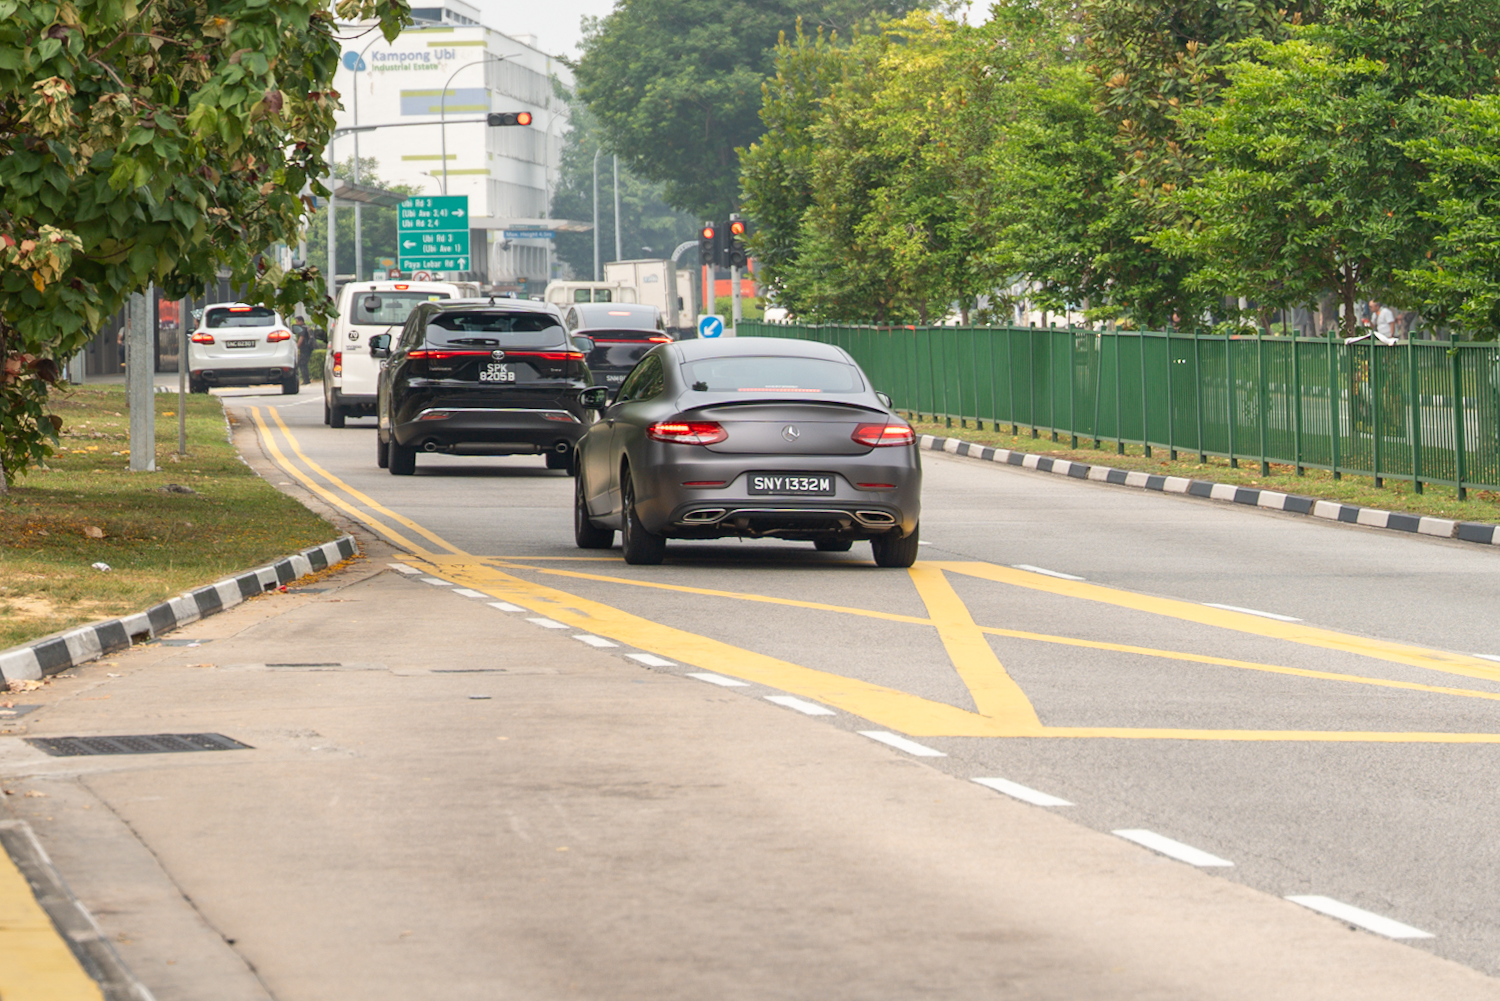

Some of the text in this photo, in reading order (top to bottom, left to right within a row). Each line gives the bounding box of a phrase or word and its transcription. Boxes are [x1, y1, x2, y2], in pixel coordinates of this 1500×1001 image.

[371, 48, 456, 63] Kampong Ubi
[371, 62, 411, 72] Industrial
[413, 62, 438, 71] Estate
[401, 198, 432, 208] Ubi Rd 3
[402, 209, 416, 218] (Ubi
[418, 209, 431, 218] Ave
[402, 219, 413, 228] Ubi
[415, 219, 425, 228] Rd
[422, 234, 453, 243] Ubi Rd 3
[422, 244, 437, 253] (Ubi
[439, 244, 452, 253] Ave
[404, 259, 454, 270] Paya Lebar Rd
[487, 363, 509, 373] SPK
[479, 371, 515, 382] 8205B
